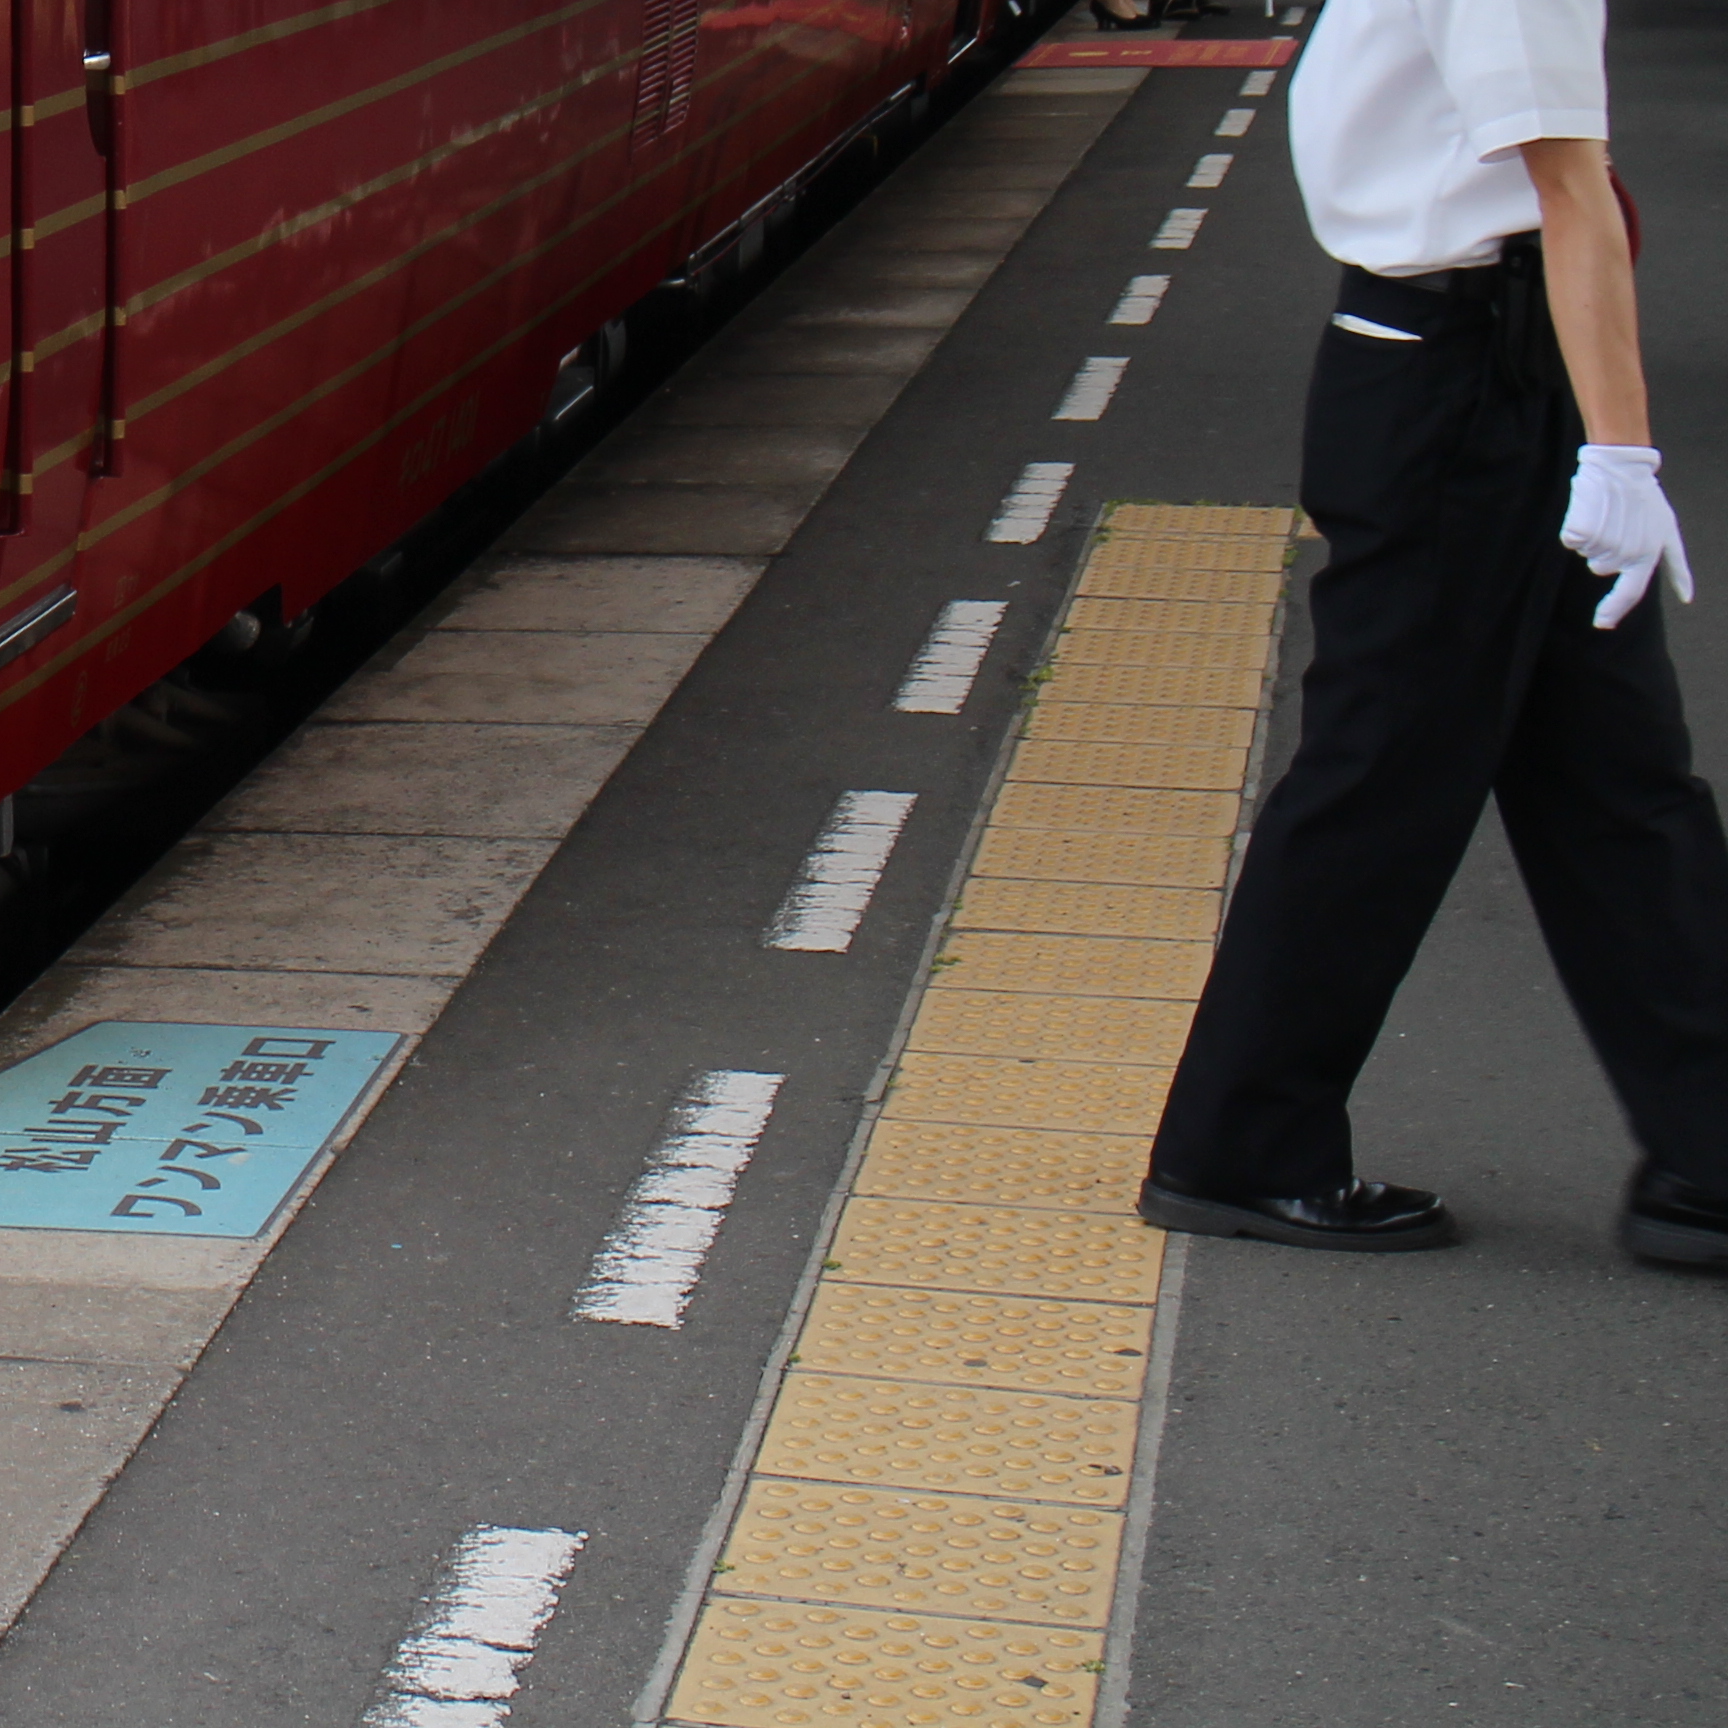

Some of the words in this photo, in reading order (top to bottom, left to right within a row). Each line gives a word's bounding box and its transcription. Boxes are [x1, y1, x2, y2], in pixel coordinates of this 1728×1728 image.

[110, 1036, 337, 1218] ワンマン乗車口
